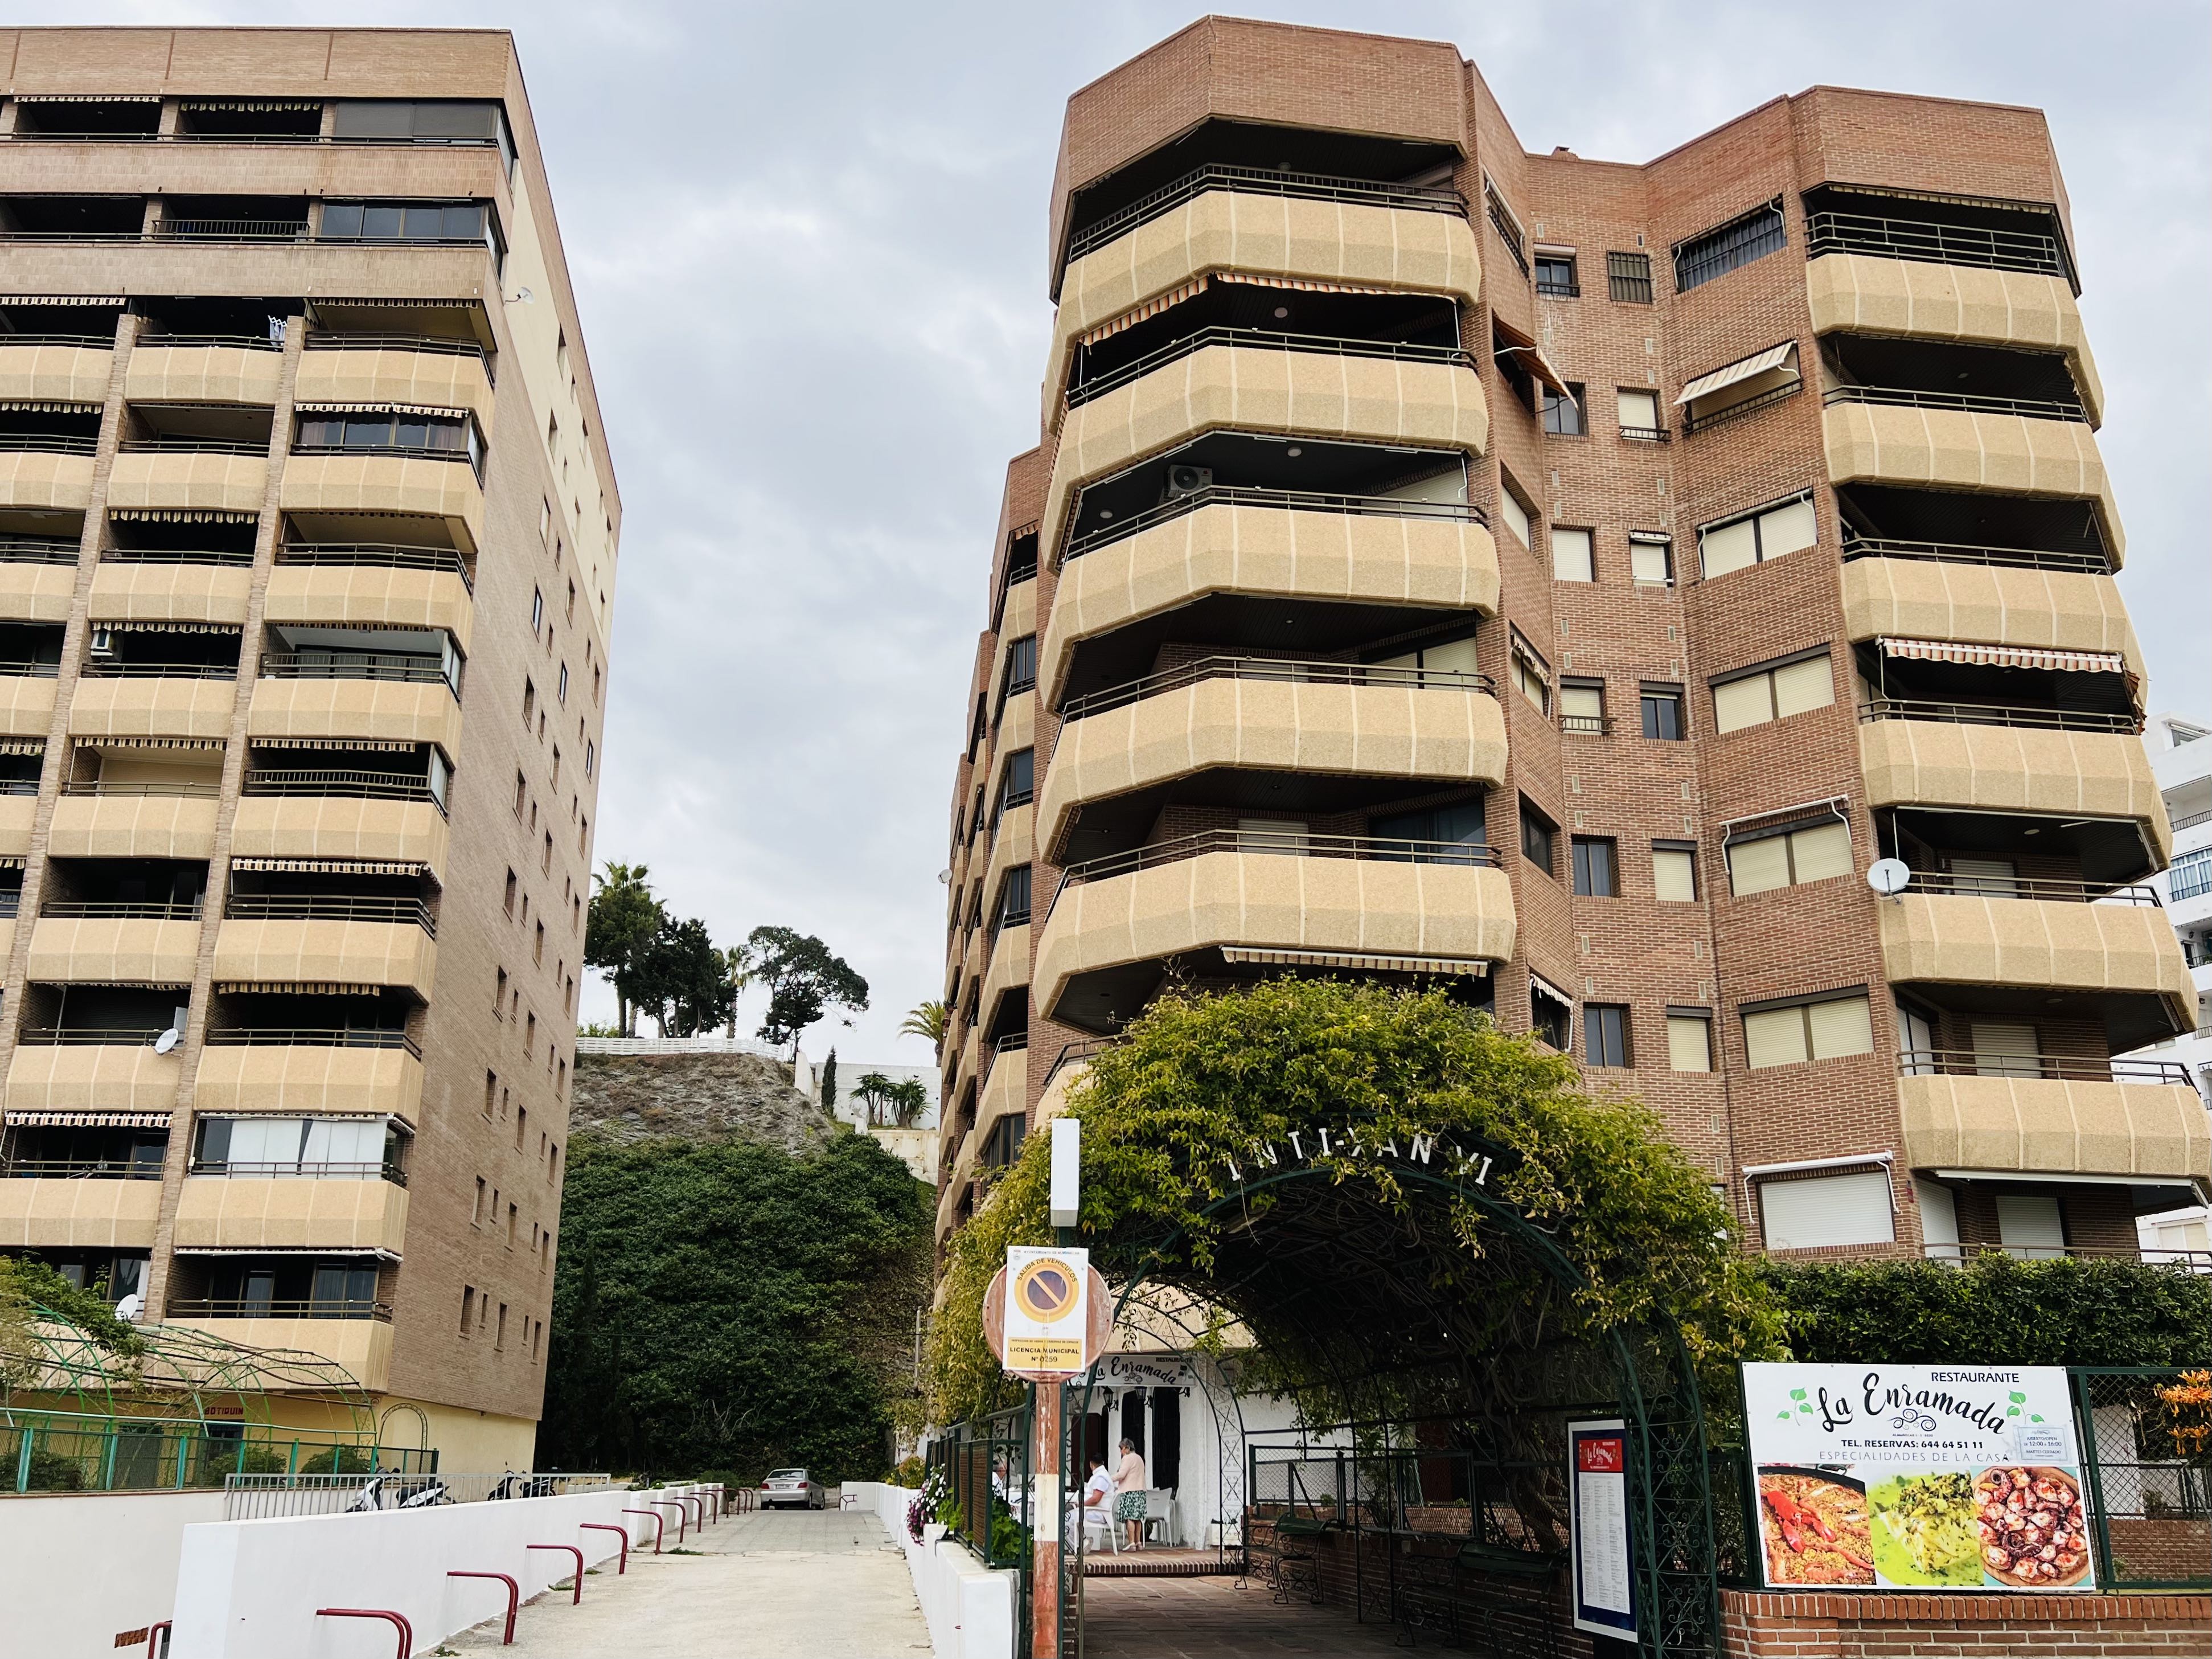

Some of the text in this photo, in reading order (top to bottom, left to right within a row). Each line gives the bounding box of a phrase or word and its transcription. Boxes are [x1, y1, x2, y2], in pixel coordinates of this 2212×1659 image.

[1017, 1261, 1036, 1281] SALIDA
[1047, 1257, 1077, 1283] VEHICULOS
[1111, 1356, 1176, 1384] Enramada
[1931, 1372, 2020, 1383] RESTAURANTE
[1816, 1372, 2005, 1435] La Enramada
[205, 1407, 244, 1415] BOTIQUIN
[1865, 1440, 1919, 1448] RESERVAS:
[1819, 1451, 2009, 1463] ESPECIALIDADES DE LA CASA
